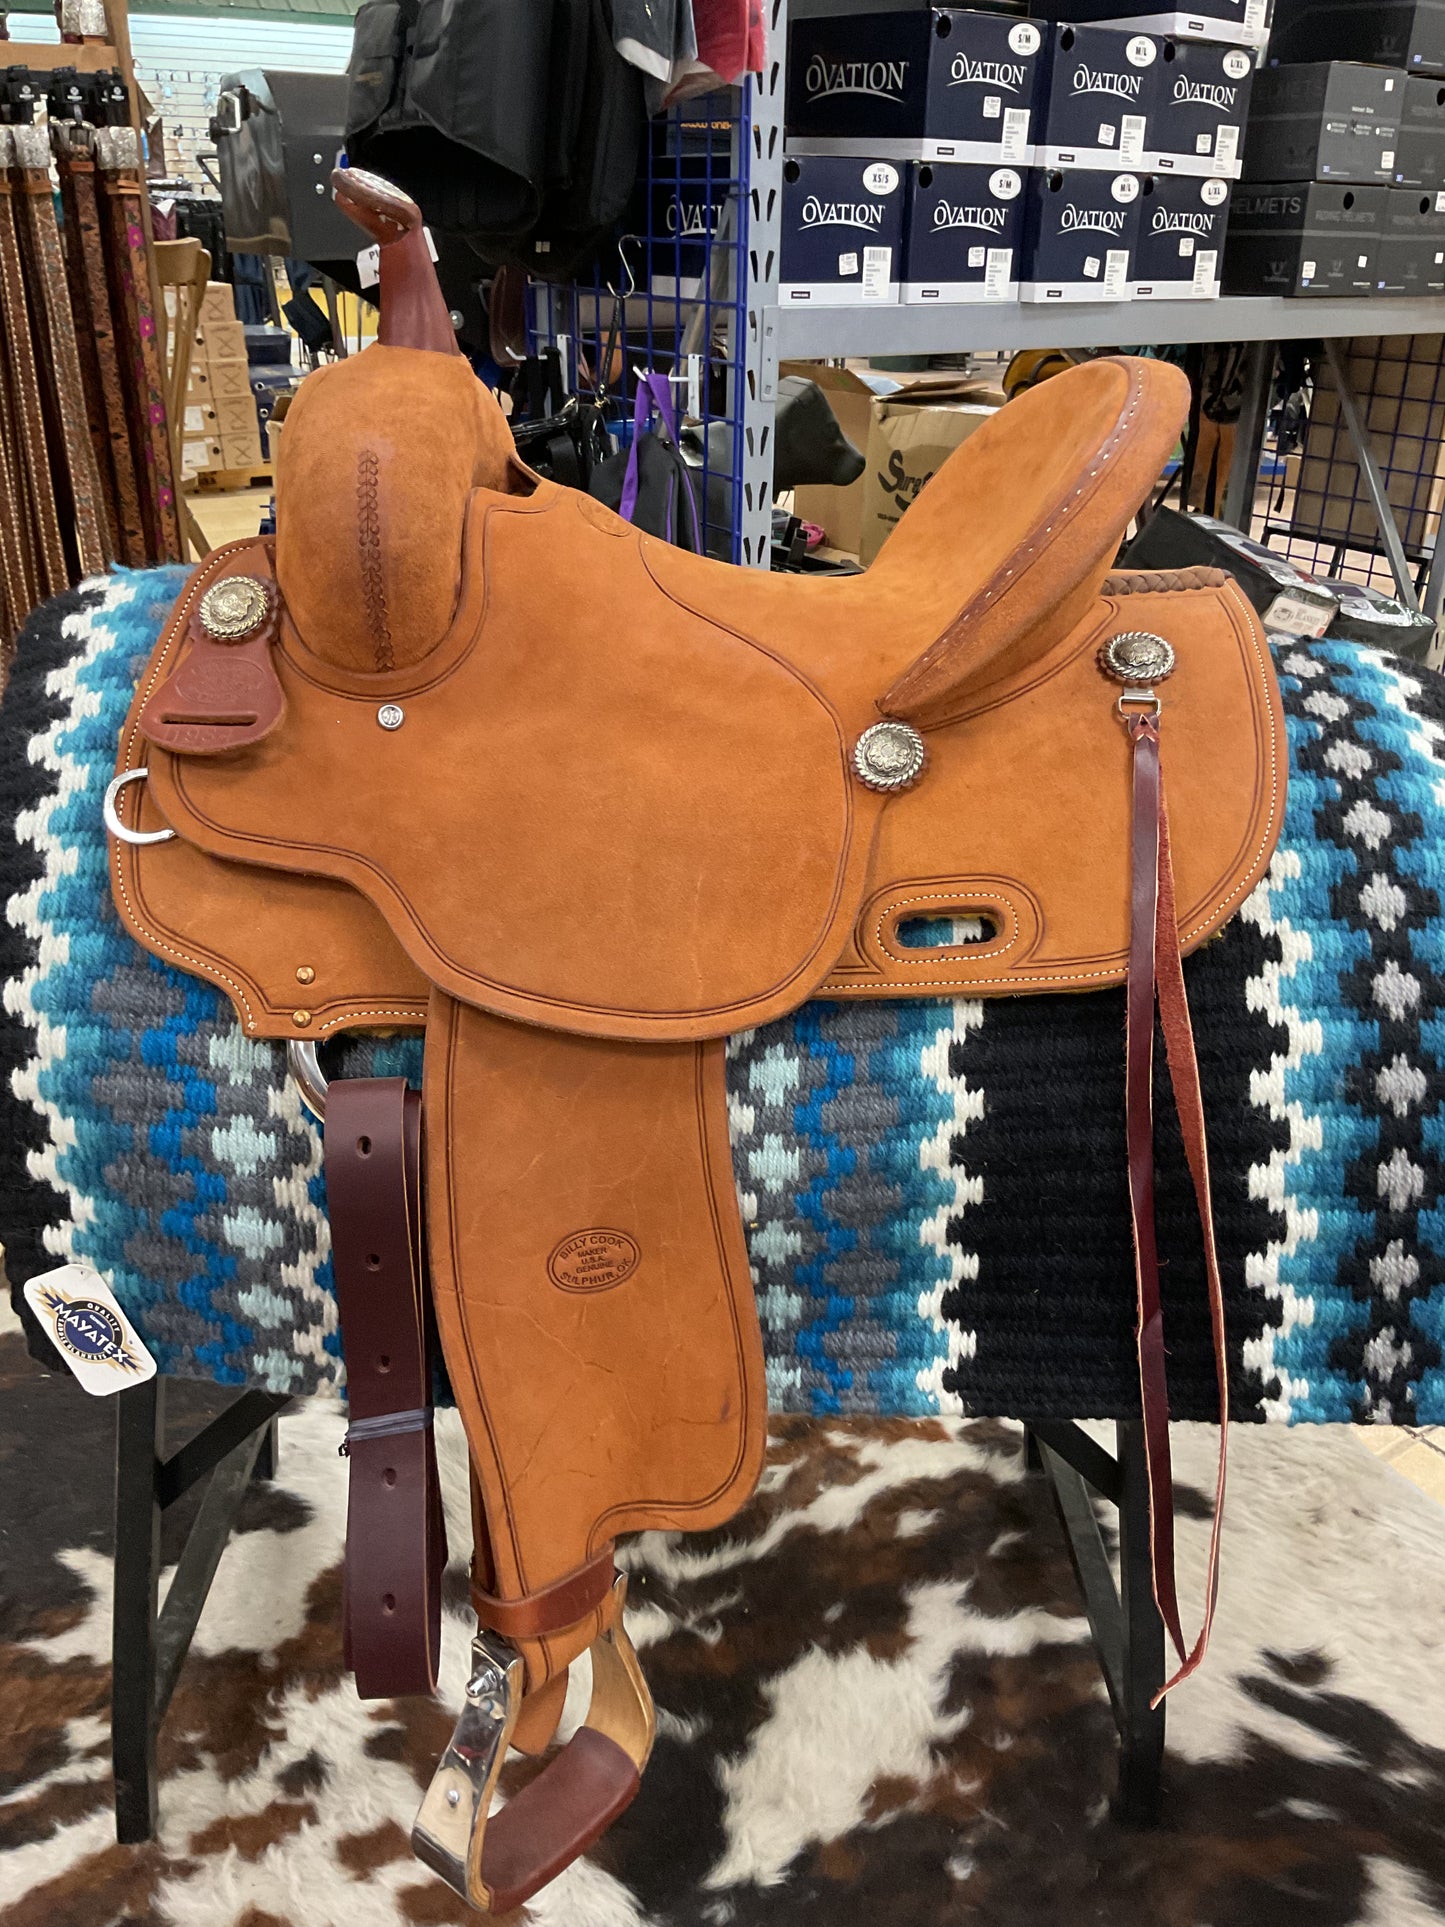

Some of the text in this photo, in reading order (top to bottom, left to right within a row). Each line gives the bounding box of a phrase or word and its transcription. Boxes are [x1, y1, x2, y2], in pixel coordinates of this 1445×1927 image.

[805, 54, 906, 92] OVATION
[951, 52, 1026, 85] OVATION
[1073, 63, 1142, 95] OVATION
[1173, 74, 1236, 105] OVATION
[872, 174, 889, 184] XS/S
[666, 194, 723, 231] OVATI
[802, 195, 883, 224] OVATION
[933, 199, 1007, 226] OVATION
[1061, 203, 1125, 229] OVATION
[1152, 206, 1214, 230] OVATION
[559, 1236, 624, 1260] BILLY COOK
[577, 1247, 607, 1257] MAKER
[576, 1261, 614, 1273] GENUINE
[616, 1258, 632, 1273] OK
[87, 1302, 121, 1331] QUALITY
[54, 1303, 128, 1362] MAYATEX
